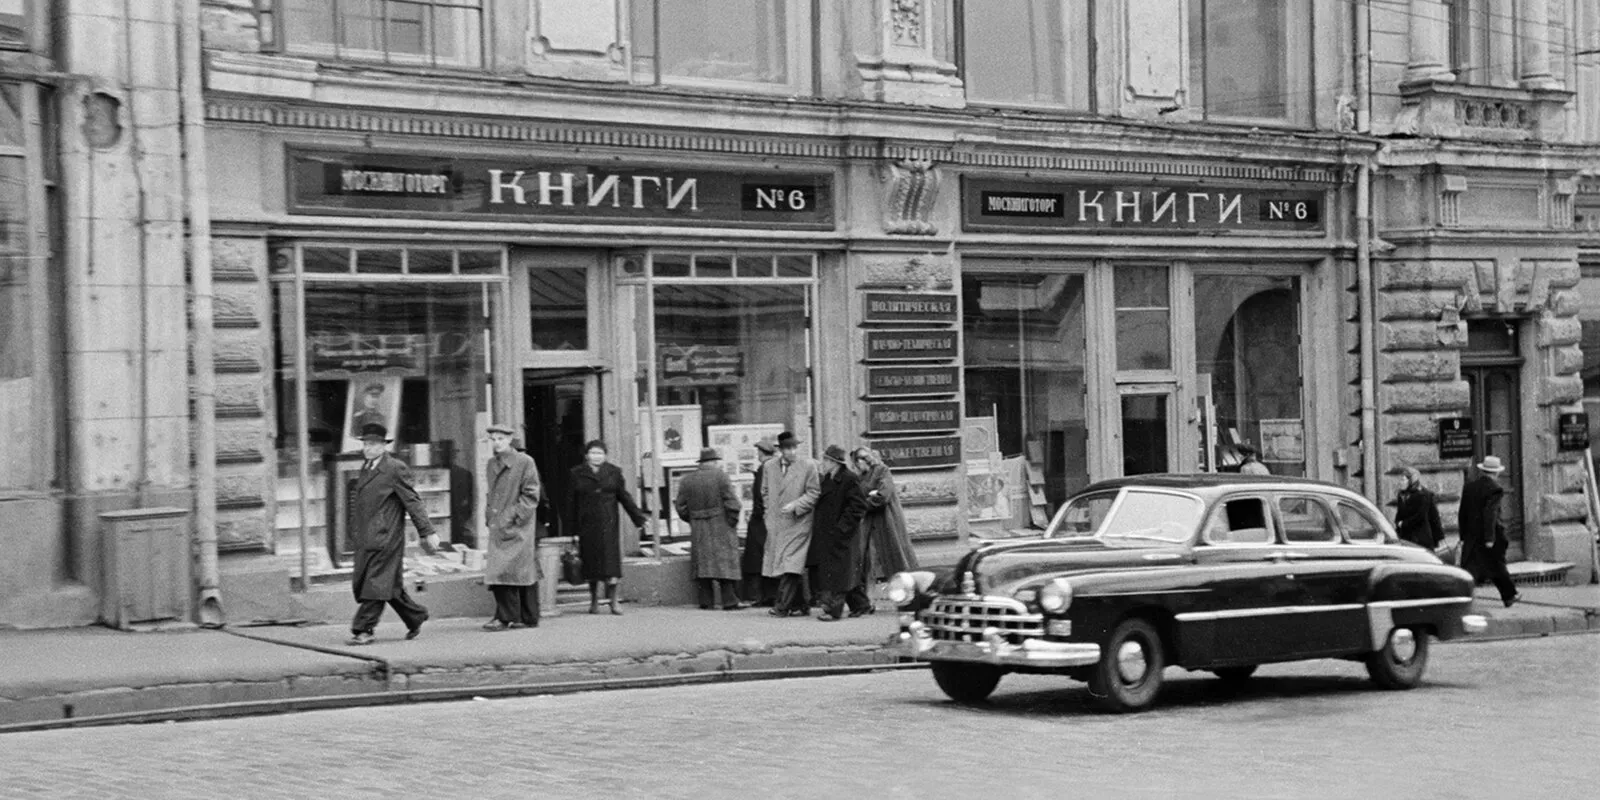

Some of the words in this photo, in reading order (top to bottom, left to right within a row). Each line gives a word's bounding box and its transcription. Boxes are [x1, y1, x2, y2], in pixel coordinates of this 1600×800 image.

[488, 169, 697, 210] КНИГИ
[756, 188, 784, 208] №
[788, 190, 805, 210] 6
[988, 196, 1057, 213] МОСКНИГОТОРГ
[1078, 190, 1242, 224] КНИГИ
[1269, 201, 1290, 219] №
[1294, 201, 1308, 220] 6
[871, 300, 952, 313] ПОЛИТИЧЕСКАЯ
